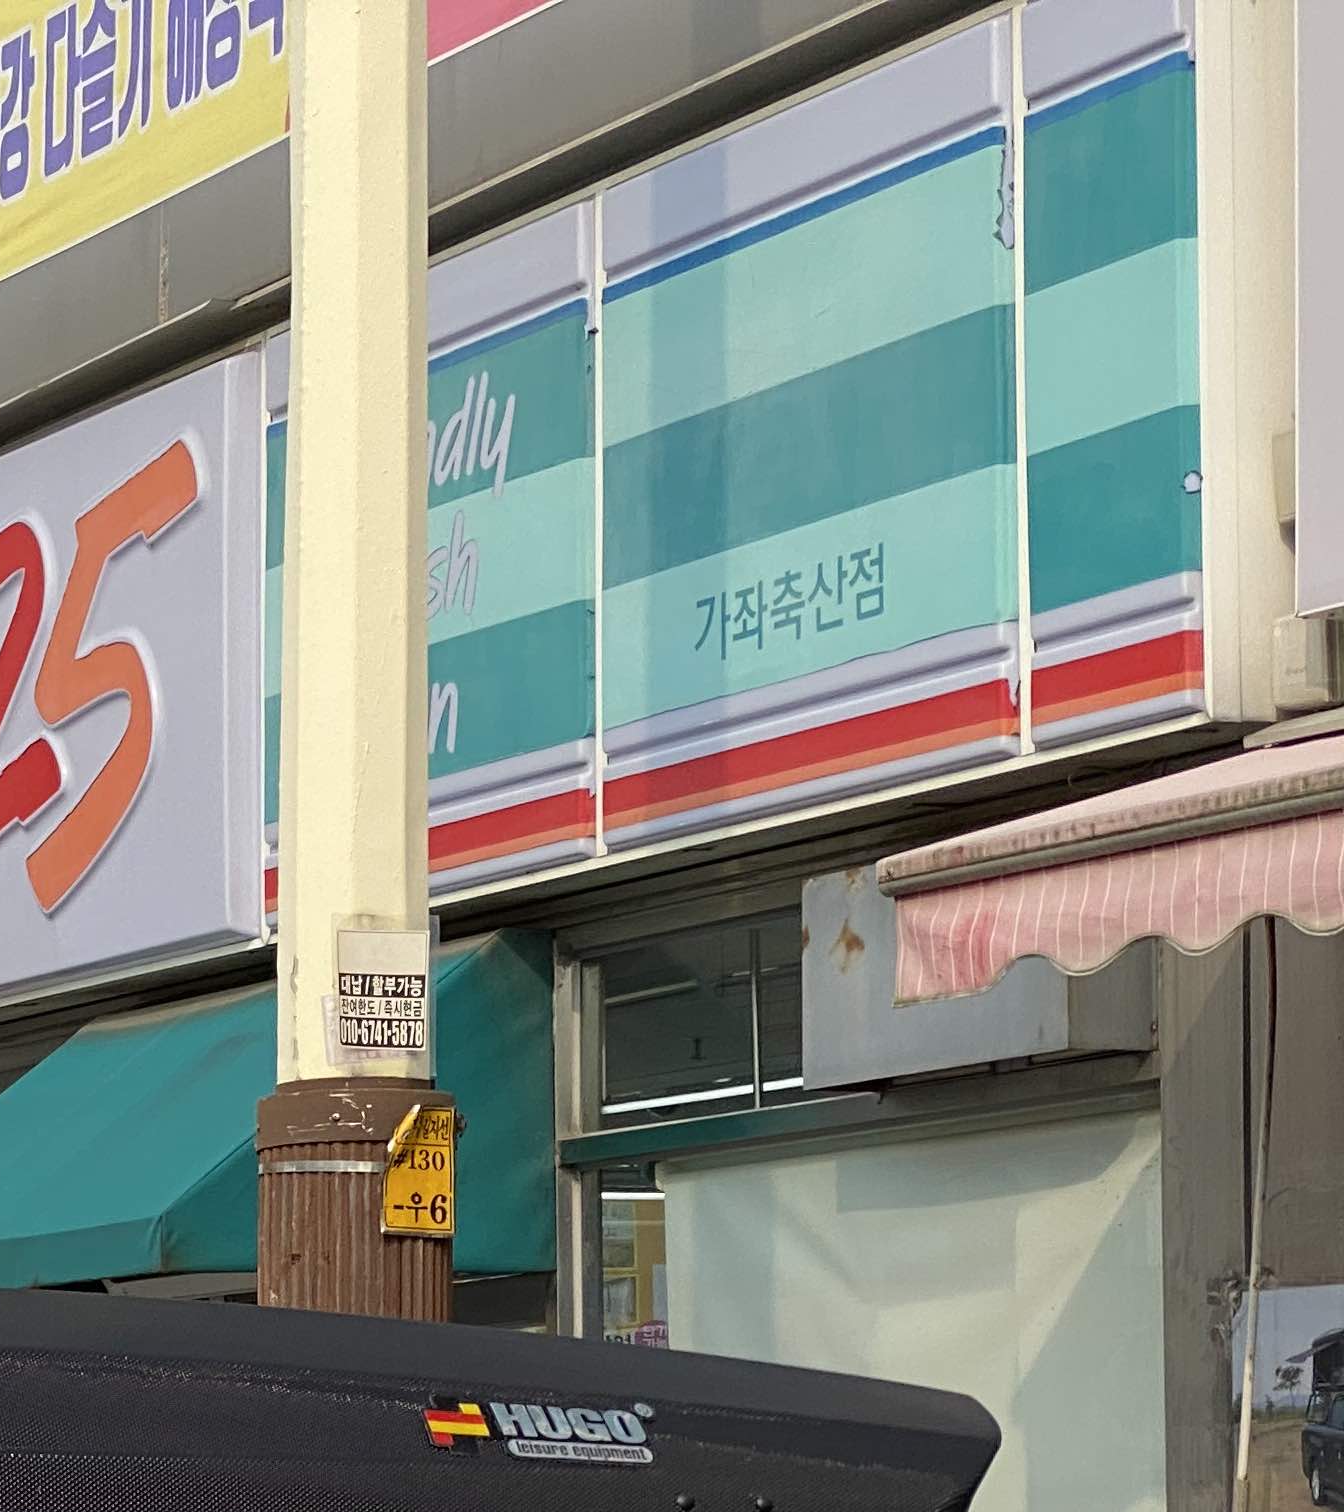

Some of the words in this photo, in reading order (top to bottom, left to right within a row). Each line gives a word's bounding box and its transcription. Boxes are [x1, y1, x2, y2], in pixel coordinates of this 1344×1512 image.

[43, 0, 152, 178] 다슬기
[693, 541, 886, 661] 가좌축산점
[340, 1017, 424, 1047] 010-6741-5878
[392, 1148, 446, 1172] #130
[488, 1401, 647, 1444] HUGO
[515, 1440, 569, 1457] leisure
[572, 1444, 648, 1463] equipment
